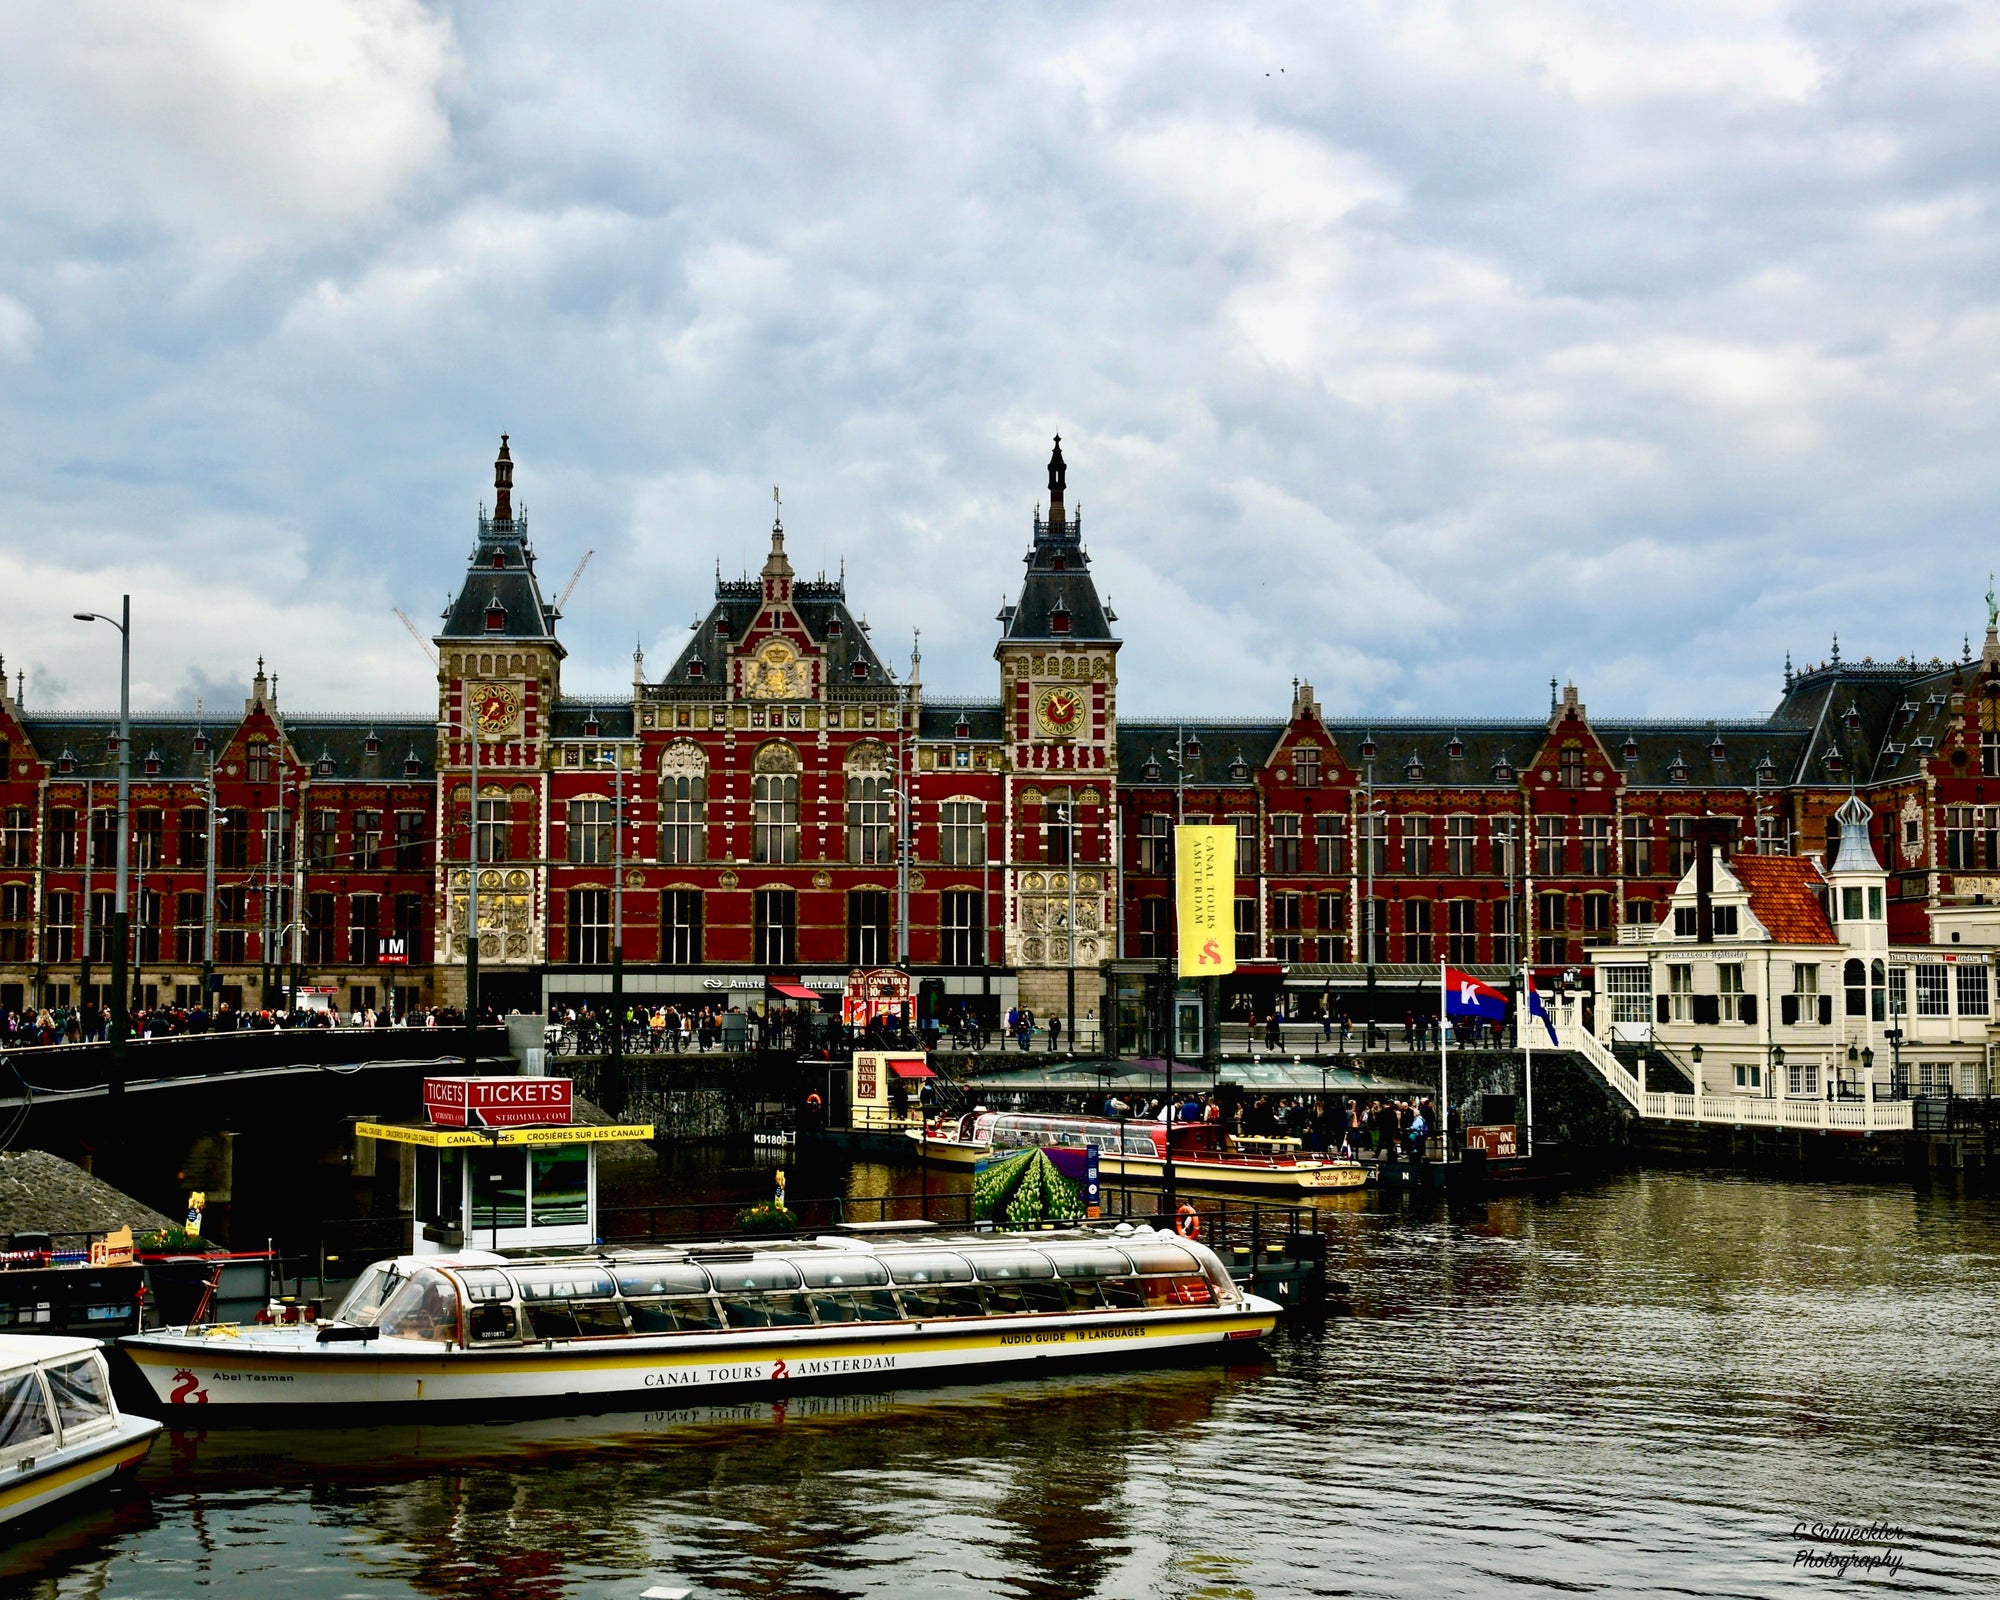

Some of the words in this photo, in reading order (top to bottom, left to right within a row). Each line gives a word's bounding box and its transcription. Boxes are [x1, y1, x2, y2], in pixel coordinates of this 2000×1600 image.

[1205, 835, 1214, 880] CANAL
[1193, 840, 1203, 924] AMSTERDAM
[1206, 886, 1215, 929] TOURS
[389, 939, 404, 954] M
[868, 977, 888, 985] CANAL
[890, 977, 908, 985] TOUR
[1563, 972, 1574, 982] M
[729, 979, 765, 989] Amste
[801, 979, 844, 989] entraal
[1460, 980, 1481, 1005] K
[428, 1083, 463, 1102] TICKETS
[476, 1084, 562, 1102] TICKETS
[495, 1112, 566, 1121] STROMMA.COM
[447, 1136, 476, 1144] CANAL
[575, 1131, 592, 1139] SUR
[594, 1130, 609, 1138] LES
[611, 1129, 645, 1138] CANAUX
[1500, 1131, 1513, 1143] ONE
[1497, 1143, 1516, 1155] HOUR
[1401, 1171, 1410, 1180] N
[1278, 1281, 1289, 1294] N
[1000, 1334, 1032, 1344] AUDIO
[1035, 1332, 1066, 1343] GUIDE
[1075, 1331, 1085, 1340] 19
[1088, 1327, 1146, 1340] LANGUAGES
[213, 1372, 241, 1381] Abel
[245, 1374, 294, 1382] Tasman
[644, 1371, 700, 1387] CANAL
[707, 1366, 762, 1381] TOURS
[797, 1356, 897, 1375] AMSTERDAM
